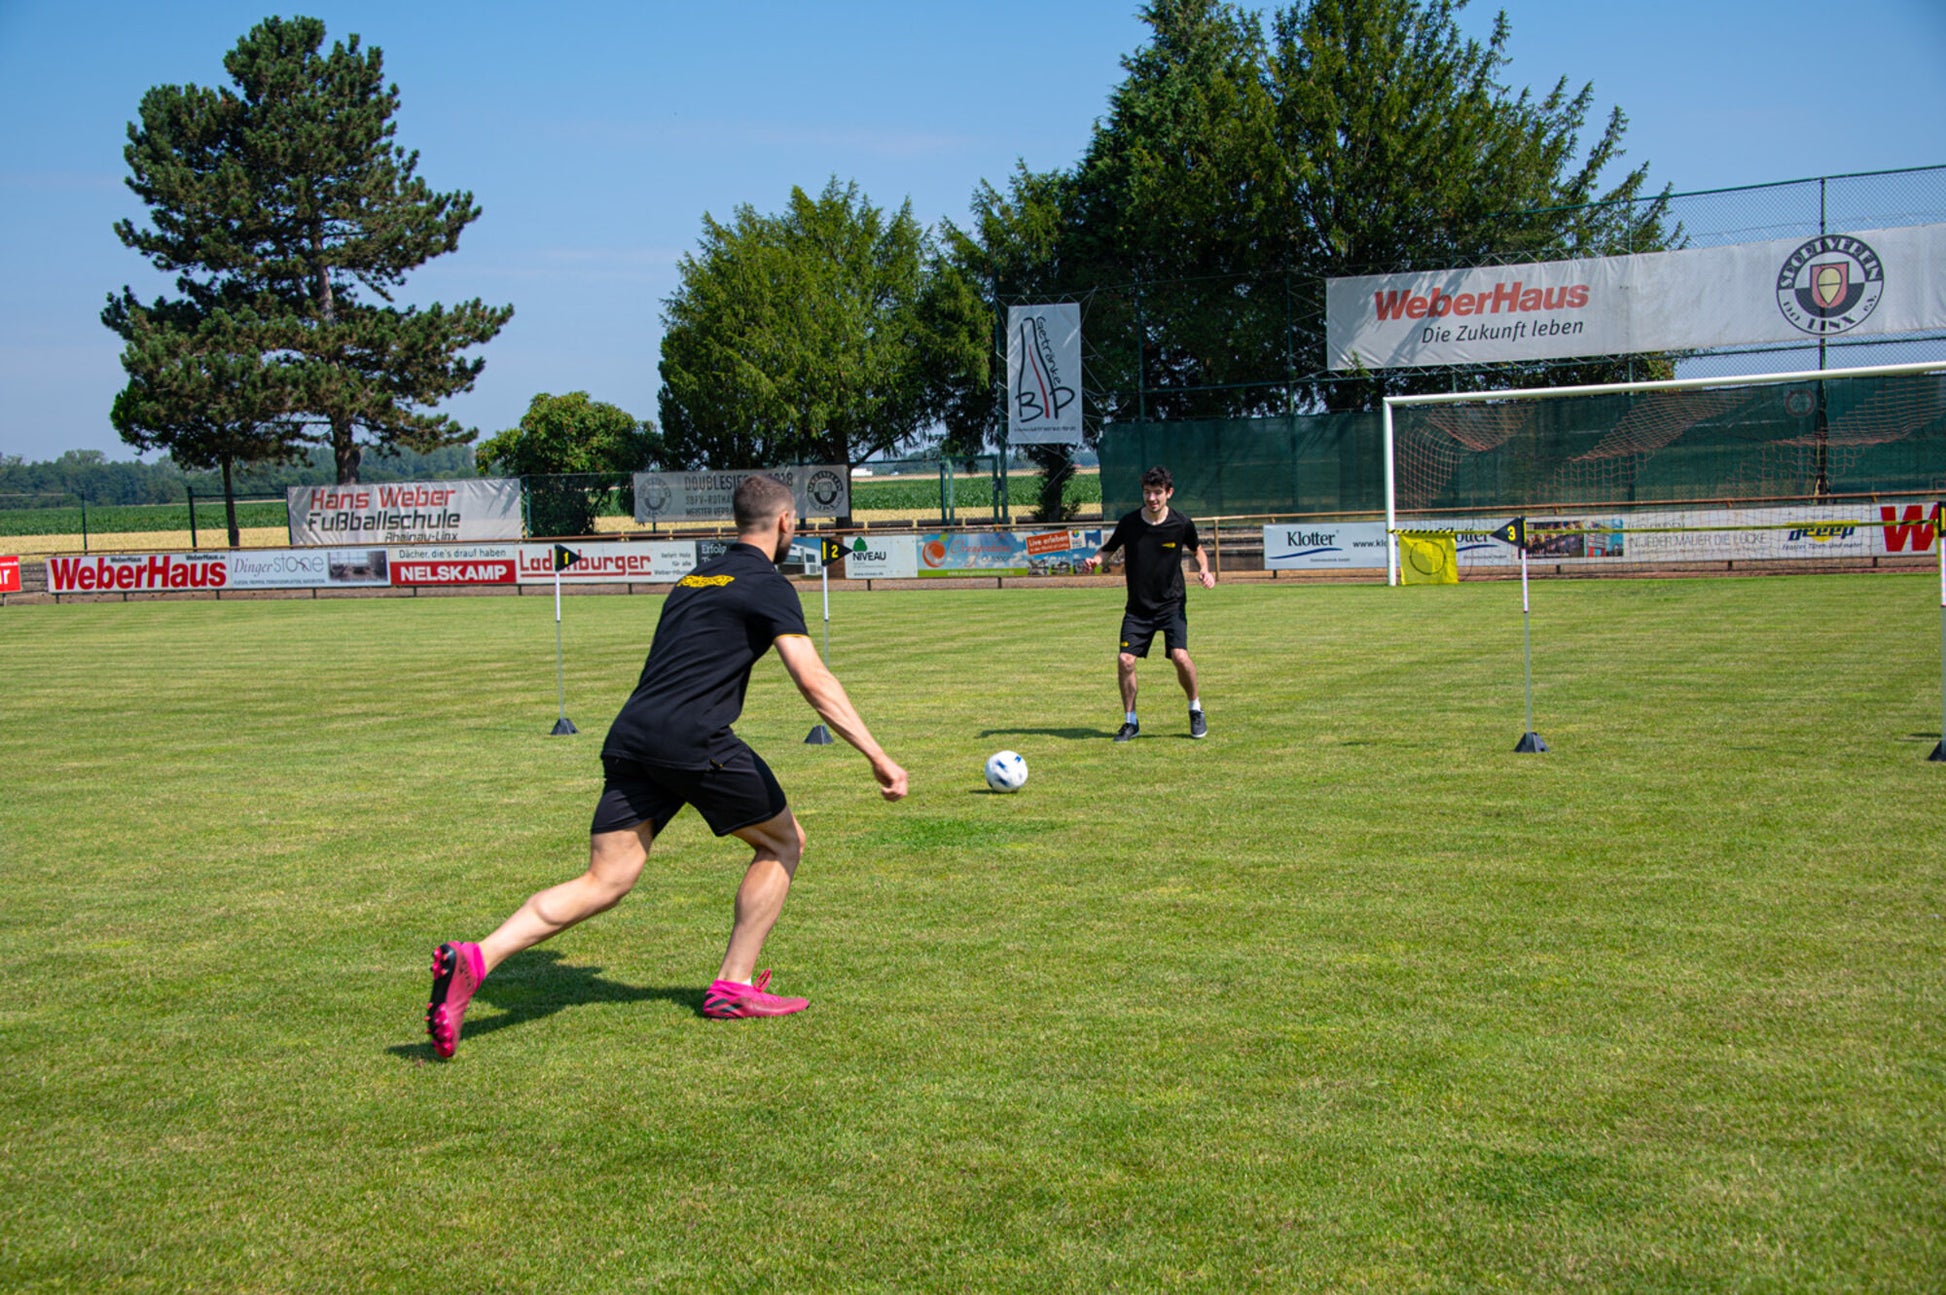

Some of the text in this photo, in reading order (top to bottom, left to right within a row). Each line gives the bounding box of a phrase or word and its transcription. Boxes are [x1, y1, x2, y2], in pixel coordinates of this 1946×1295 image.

[1375, 281, 1590, 321] WeberHaus
[1421, 319, 1584, 344] Die Zukunft leben
[310, 487, 456, 510] Hans Weber
[309, 509, 460, 532] Fußballschule
[1287, 531, 1335, 546] Klotter
[1507, 525, 1516, 541] 3
[480, 547, 506, 557] haben
[563, 553, 569, 565] 1
[831, 545, 839, 558] 2
[853, 551, 887, 561] NIVEAU
[50, 555, 227, 590] WeberHaus
[400, 565, 507, 581] NELSKAMP
